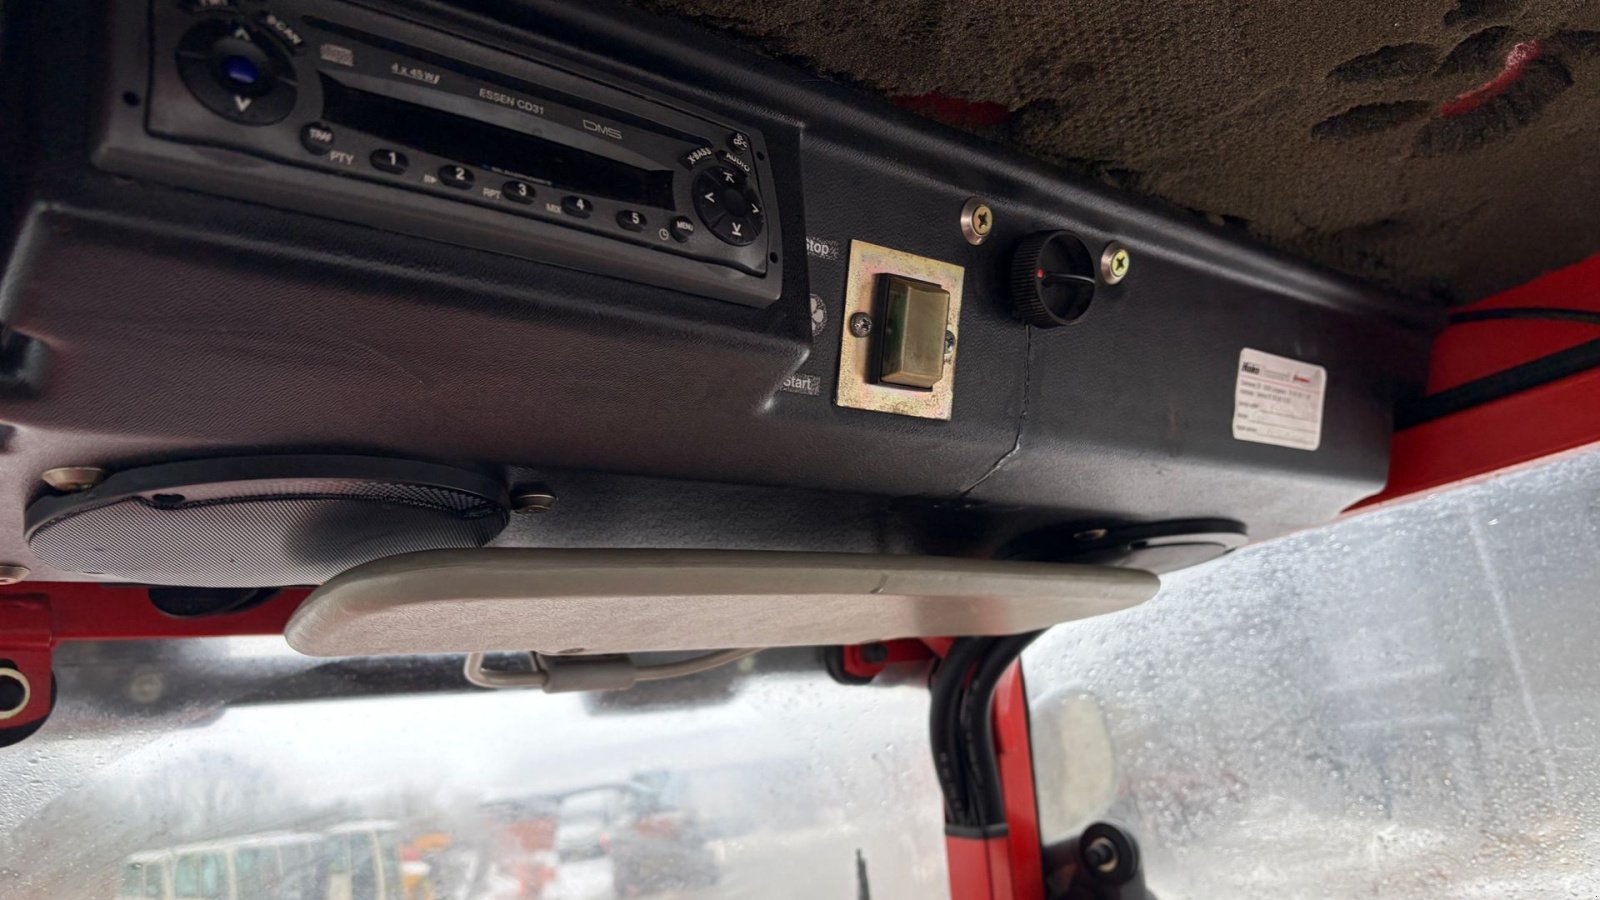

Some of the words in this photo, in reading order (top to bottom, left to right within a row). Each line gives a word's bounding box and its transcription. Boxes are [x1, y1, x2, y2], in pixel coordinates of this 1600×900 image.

[479, 88, 515, 107] ESSEN
[517, 99, 545, 115] CD31
[582, 119, 623, 140] DMS
[329, 150, 355, 166] PTY
[388, 152, 397, 166] 1
[726, 152, 750, 172] AUDIO
[455, 167, 465, 180] 2
[518, 183, 527, 196] 3
[576, 198, 584, 211] 4
[631, 212, 640, 225] 5
[676, 220, 694, 232] MENU
